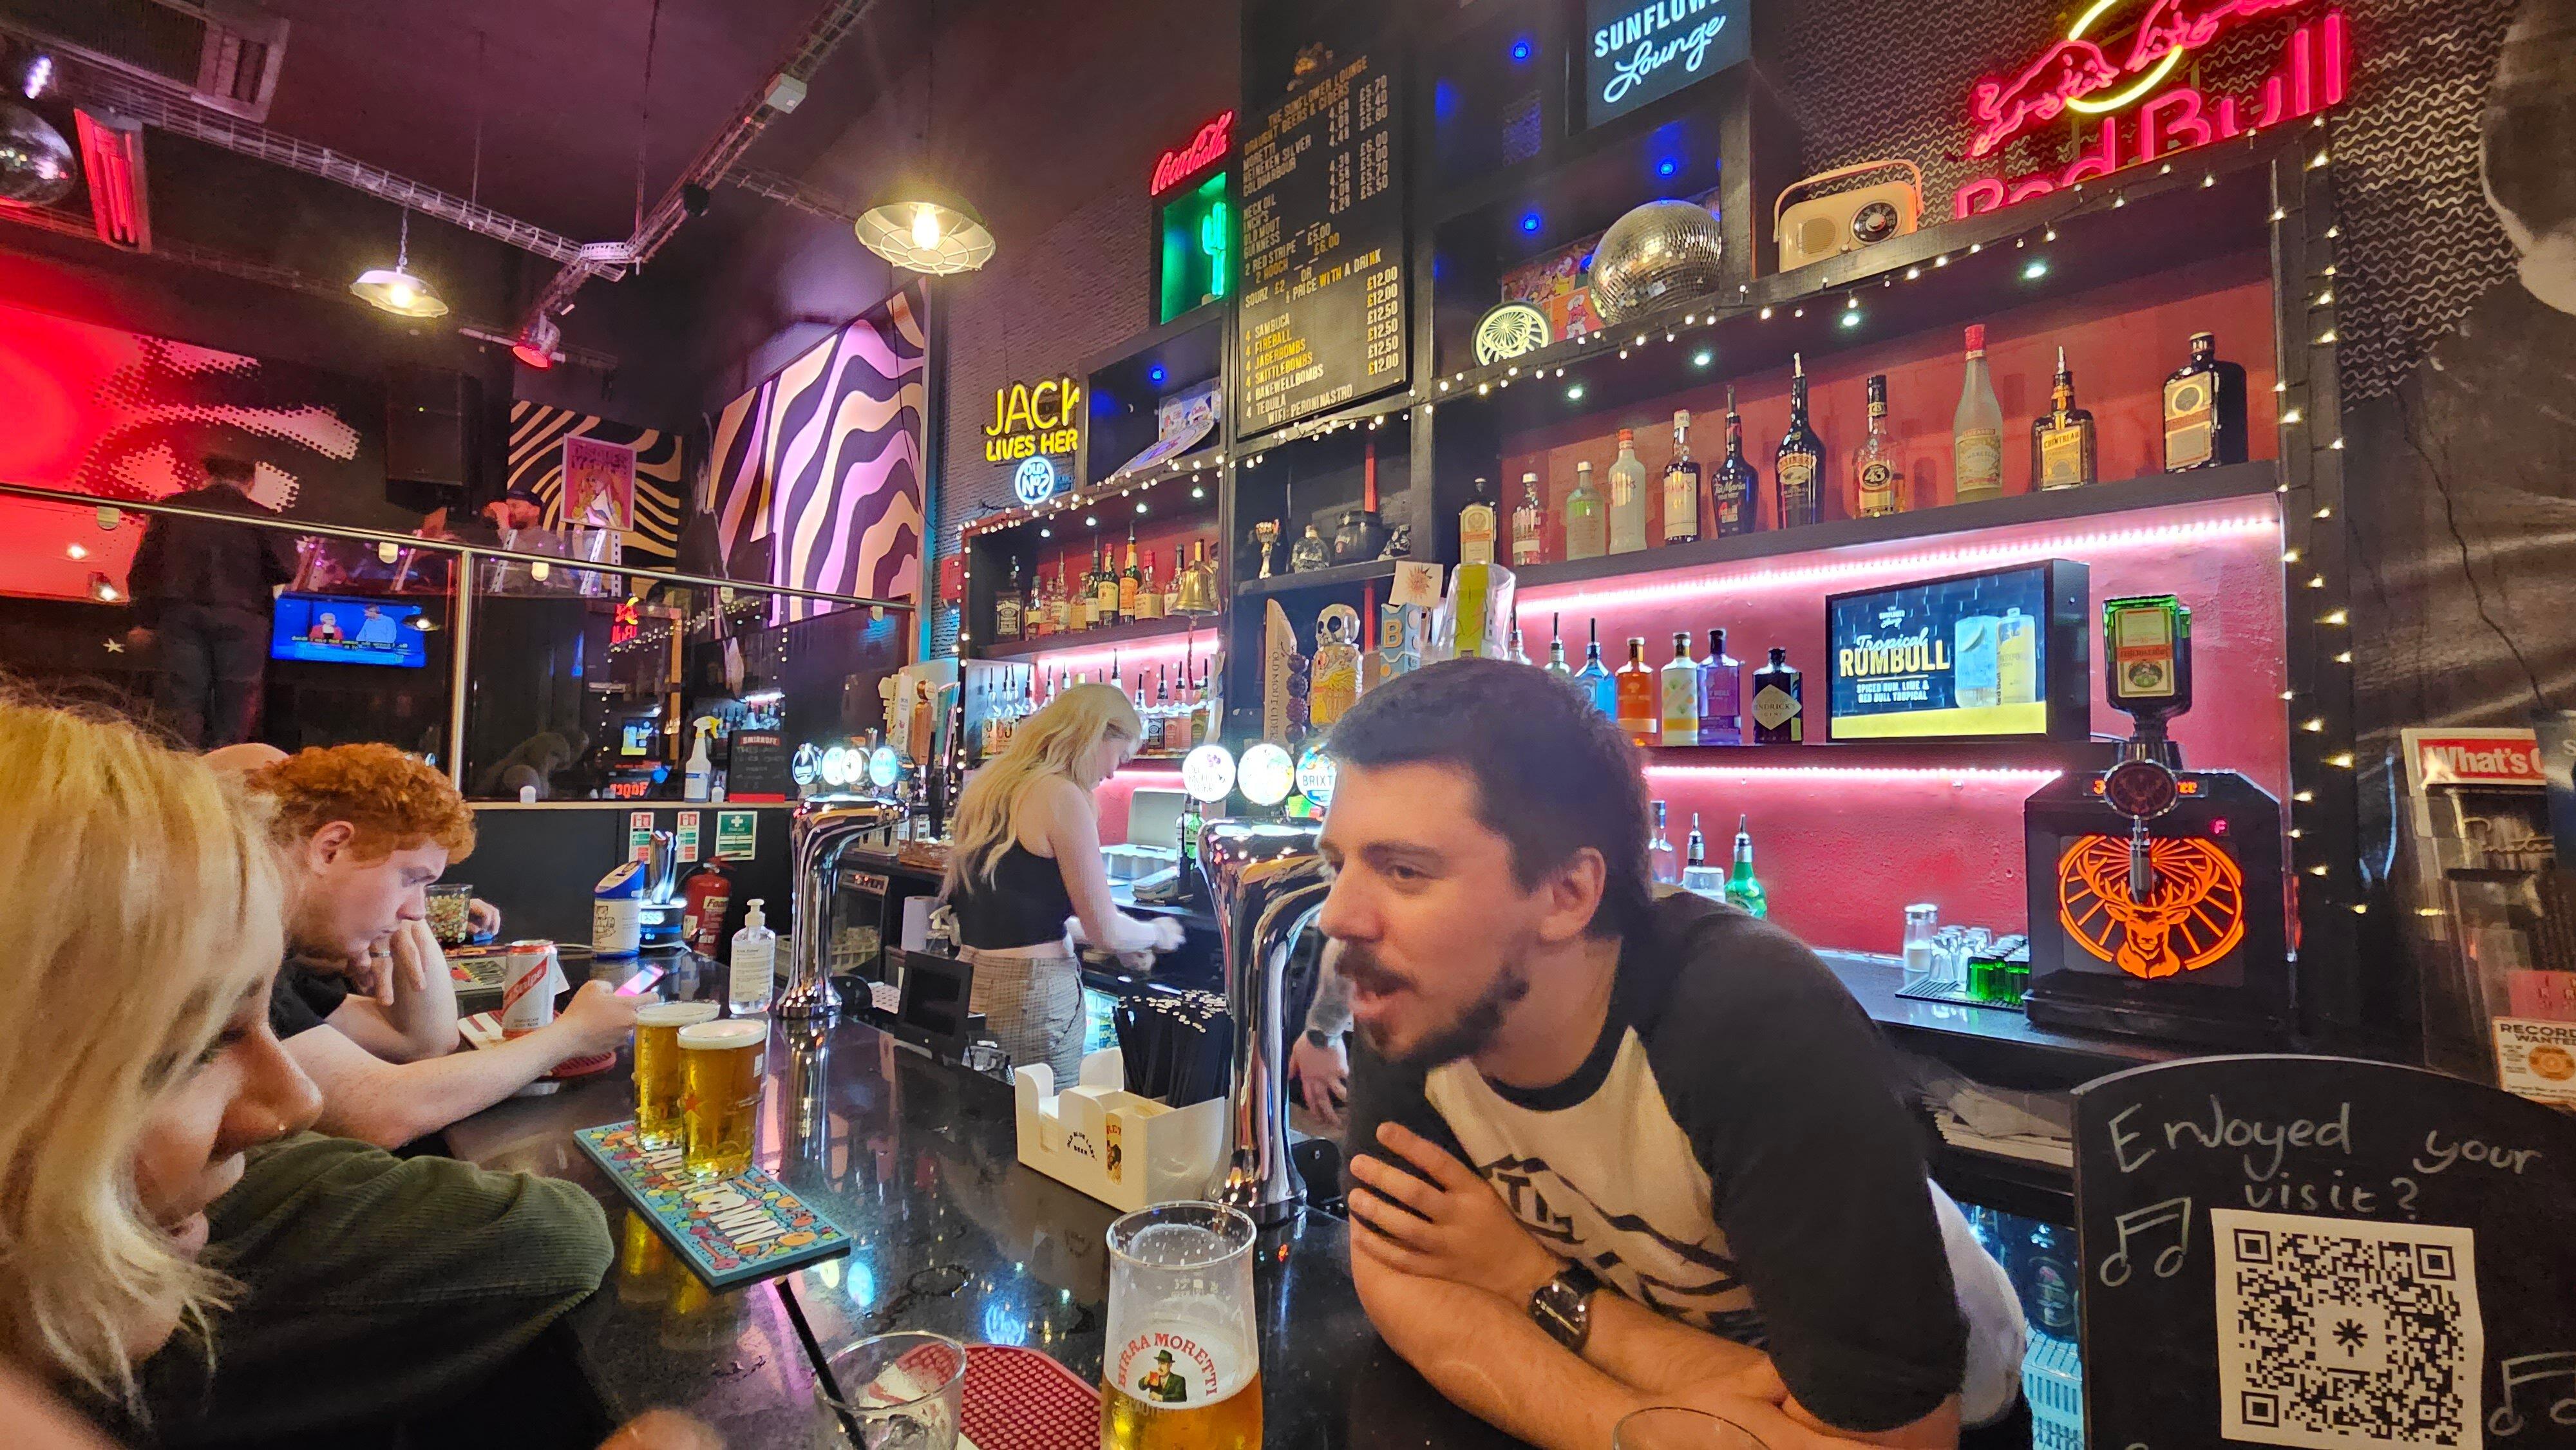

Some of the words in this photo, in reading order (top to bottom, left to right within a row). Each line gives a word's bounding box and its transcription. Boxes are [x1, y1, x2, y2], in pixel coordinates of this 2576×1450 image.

[1603, 15, 1726, 102] Lounge
[1268, 109, 1282, 127] THE
[1285, 78, 1332, 117] SUNFLOWER
[1334, 55, 1368, 86] LOUNGE
[1320, 81, 1350, 111] CIDERS
[2141, 13, 2342, 163] Bull
[1244, 142, 1276, 171] MORETTI
[1244, 153, 1280, 185] HEINEKEN
[1283, 134, 1311, 161] SILVER
[1264, 193, 1276, 209] OIL
[1244, 231, 1280, 259] GUINNESS
[1245, 263, 1250, 276] 2
[1253, 255, 1267, 272] RED
[1269, 240, 1296, 264] STRIPE
[1308, 223, 1331, 245] £5.00
[1256, 271, 1262, 283] 2
[1264, 258, 1288, 281] HOOCH
[1314, 232, 1340, 256] £6.00
[1245, 286, 1268, 308] SOURZ
[1274, 279, 1285, 295] £2
[1301, 266, 1312, 282] OR
[1293, 278, 1317, 301] PRICE
[1319, 266, 1341, 288] WITH
[1344, 262, 1351, 277] A
[1354, 249, 1382, 273] DRINK
[1367, 266, 1398, 291] £12.00
[1367, 283, 1398, 308] £12.00
[1245, 330, 1251, 343] 4
[1255, 313, 1290, 338] SAMBUCA
[1367, 301, 1398, 325] £12.50
[1245, 346, 1251, 357] 4
[1255, 330, 1293, 354] FIREBALL
[1367, 317, 1398, 342] £12.50
[1245, 360, 1251, 372] 4
[1255, 338, 1306, 370] JAGERBOMBS
[1367, 335, 1399, 359] £12.50
[1245, 375, 1251, 388] 4
[1367, 353, 1399, 376] £12.00
[1246, 391, 1251, 403] 4
[1255, 364, 1324, 400] BAKEWELLBOMBS
[1246, 406, 1251, 419] 4
[1256, 393, 1286, 416] TEQUILA
[986, 434, 1036, 461] LIVES
[1041, 429, 1078, 455] HER
[1024, 459, 1045, 477] OLD
[1865, 466, 1886, 482] 43
[1383, 621, 1403, 648] B
[1857, 626, 1929, 656] Tropical
[1840, 639, 1950, 677] RUMBULL
[1271, 673, 1280, 705] MOUT
[1857, 683, 1881, 693] SPICED
[1902, 681, 1920, 690] LIME
[1858, 693, 1872, 703] RED
[1874, 693, 1891, 702] BULL
[1893, 691, 1927, 701] TROPICAL
[1269, 707, 1280, 740] CIDER
[743, 736, 777, 745] SMIRNOFF
[2423, 746, 2528, 774] What's
[1303, 775, 1333, 787] BRIXT
[1074, 1145, 1088, 1156] BEER
[2412, 1129, 2542, 1175] your
[1118, 1335, 1151, 1388] BIRRA
[1154, 1332, 1217, 1396] MORETTI
